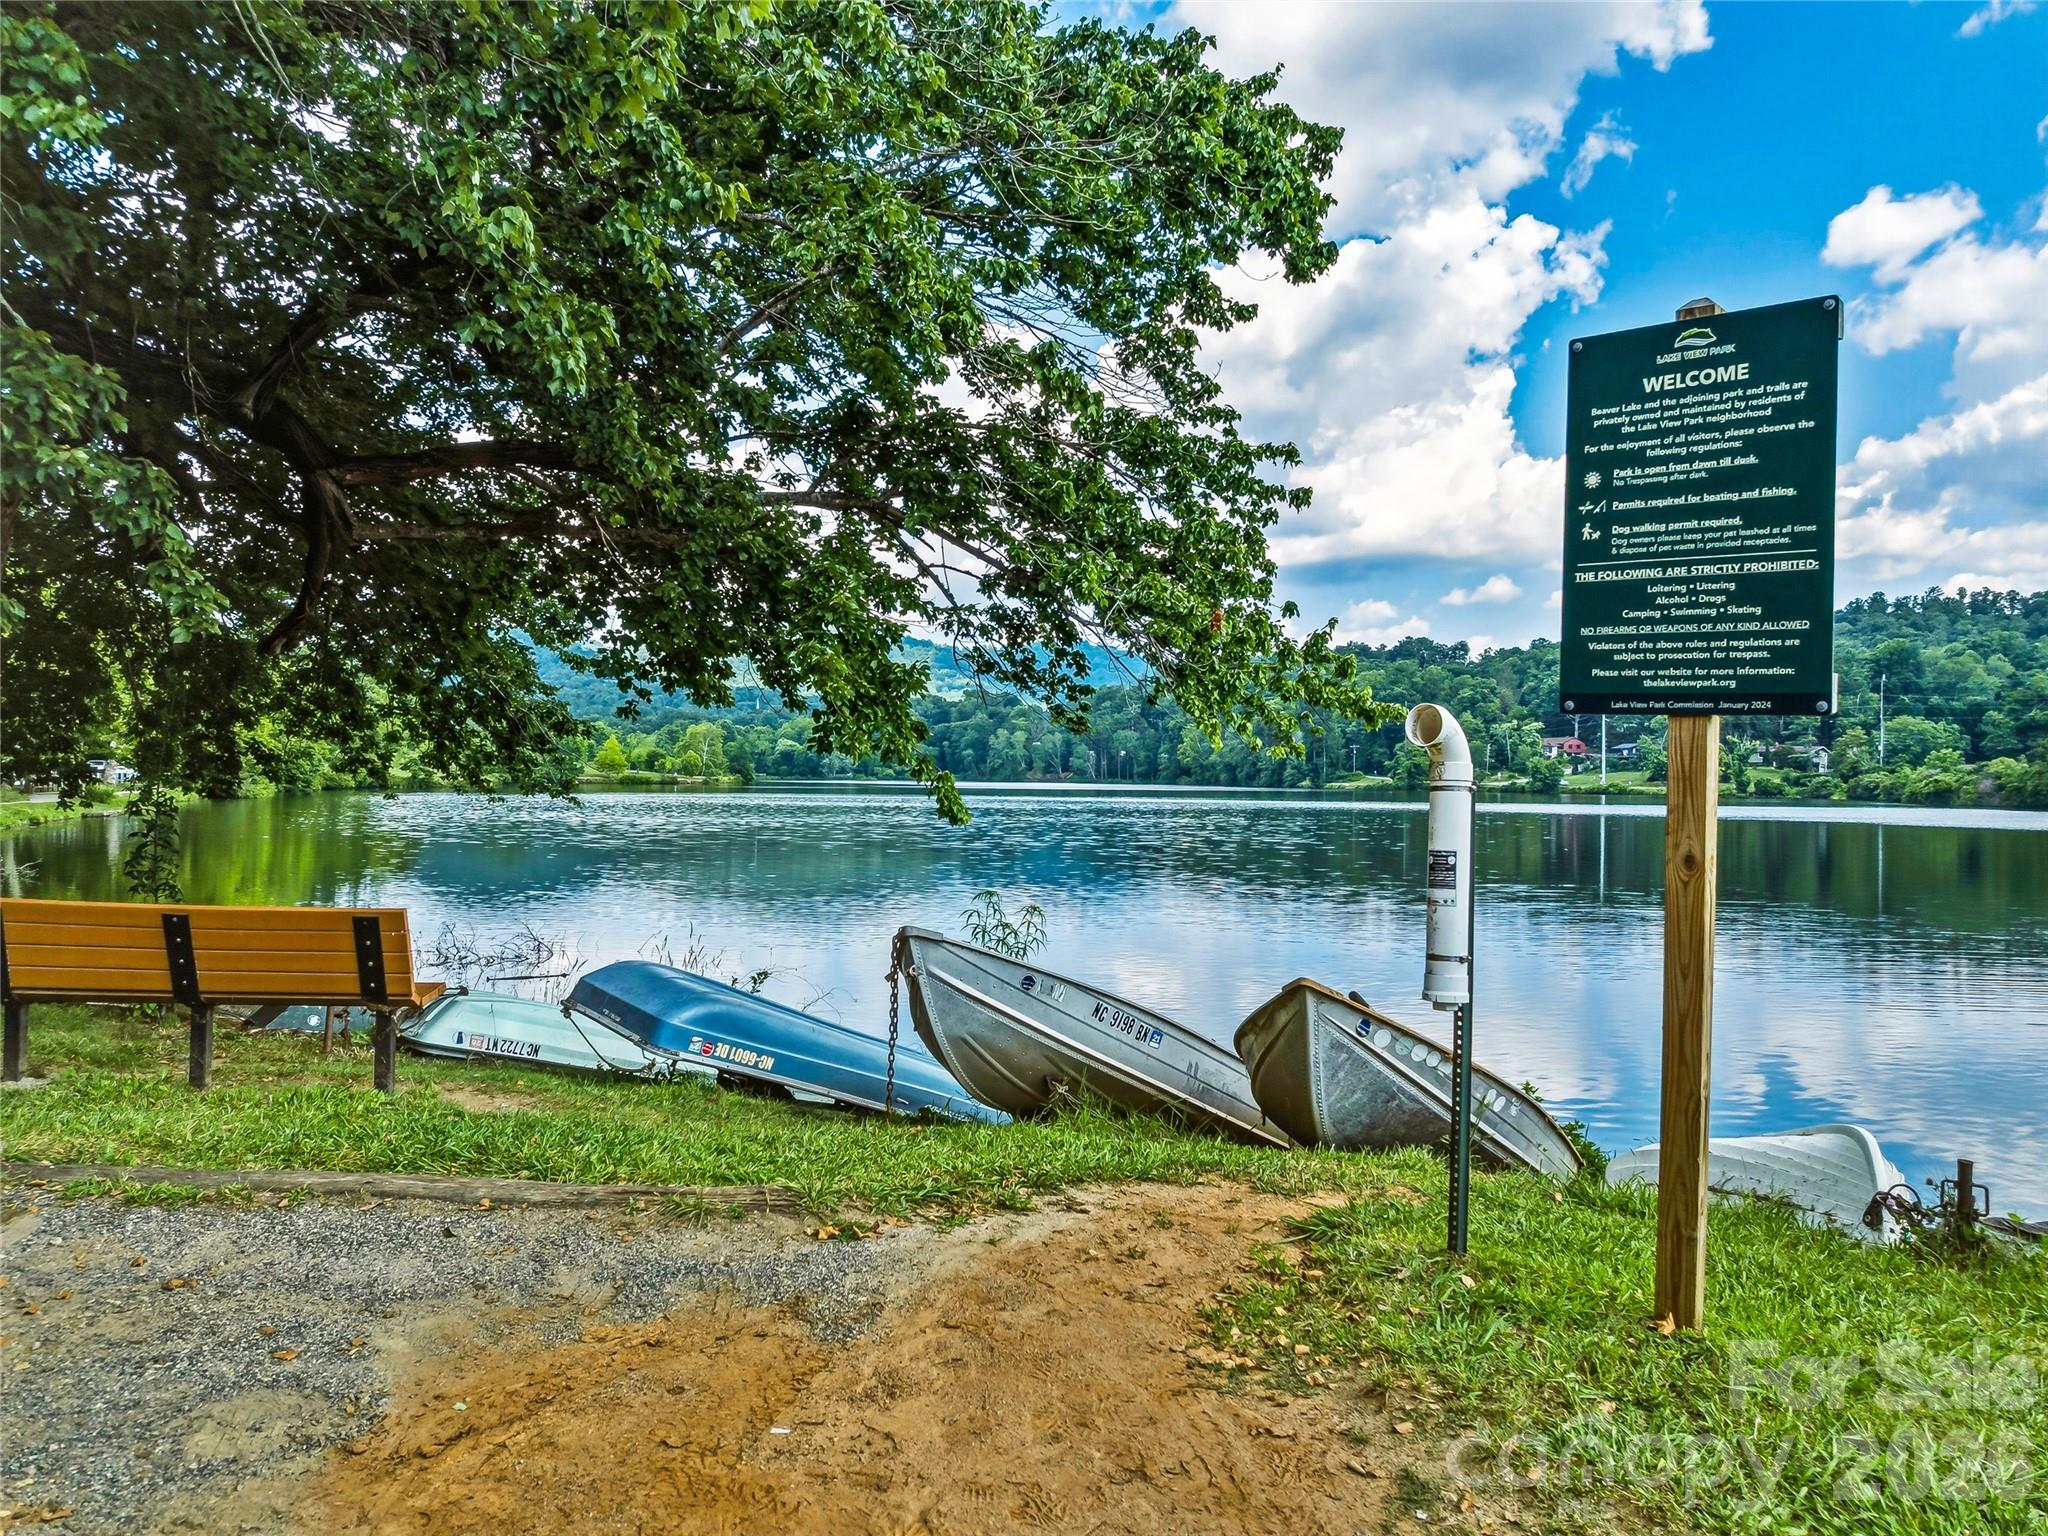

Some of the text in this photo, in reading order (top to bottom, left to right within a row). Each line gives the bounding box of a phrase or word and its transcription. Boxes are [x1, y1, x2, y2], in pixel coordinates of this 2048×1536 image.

[1656, 344, 1736, 364] LAKE VIEW PARK
[1643, 363, 1749, 393] WELCOME
[1591, 406, 1620, 416] Beaver
[1622, 403, 1641, 412] Lake
[1644, 400, 1659, 409] and
[1662, 398, 1676, 406] the
[1679, 393, 1720, 404] adjoining
[1723, 389, 1743, 400] park
[1746, 385, 1764, 395] and
[1766, 382, 1790, 392] trails
[1594, 391, 1806, 428] privately owned and maintained by residents of
[1622, 425, 1635, 433] the
[1660, 420, 1682, 428] View
[1684, 416, 1703, 425] Park
[1706, 407, 1772, 423] neighborhood
[1584, 445, 1599, 454] For
[1617, 438, 1661, 450] enjoyment
[1664, 435, 1673, 444] of
[1675, 434, 1685, 443] all
[1688, 431, 1722, 441] visitors,
[1725, 428, 1755, 439] please
[1757, 424, 1795, 433] observe
[1798, 420, 1815, 428] the
[1647, 441, 1743, 457] following regulations:
[1614, 468, 1632, 478] Park
[1635, 467, 1641, 476] is
[1644, 465, 1666, 475] open
[1669, 463, 1690, 472] from
[1692, 460, 1717, 469] dawn
[1720, 457, 1731, 467] till
[1670, 473, 1687, 481] after
[1689, 470, 1709, 479] dark.
[1613, 487, 1797, 510] Permits required for boating and fishing.
[1612, 516, 1743, 534] Dog walking permit required.
[1629, 536, 1655, 544] owners
[1657, 534, 1681, 543] please
[1683, 532, 1702, 540] keep
[1704, 531, 1721, 540] your
[1723, 530, 1737, 538] pet
[1739, 527, 1770, 536] leashed
[1782, 525, 1792, 533] all
[1649, 544, 1658, 552] of
[1659, 545, 1672, 553] pet
[1706, 539, 1741, 549] provided
[1743, 536, 1791, 546] receptacles.
[1575, 560, 1819, 582] THE FOLLOWING ARE STRICTLY PROHIBITED:
[1648, 581, 1735, 593] Loitering Littering
[1656, 594, 1726, 604] Alcohol Drugs
[1622, 605, 1762, 619] Camping Swimming Skating
[1581, 620, 1809, 635] NO FIREARMS OR WEAPONS OF ANY KIND ALLOWED
[1588, 642, 1625, 650] Violators
[1628, 641, 1637, 649] of
[1656, 640, 1683, 648] above
[1686, 640, 1708, 648] rules
[1710, 639, 1727, 647] and
[1729, 638, 1782, 649] regulations
[1614, 652, 1645, 661] subject
[1658, 651, 1710, 661] prosecution
[1713, 650, 1726, 658] for
[1729, 651, 1771, 660] trespass.
[1621, 668, 1638, 676] visit
[1695, 667, 1708, 675] for
[1737, 666, 1795, 675] information:
[1644, 678, 1736, 688] thelakeviewpark.org
[1718, 701, 1749, 710] January
[1091, 1001, 1150, 1043] NC 9198 BN
[714, 1042, 730, 1058] DE
